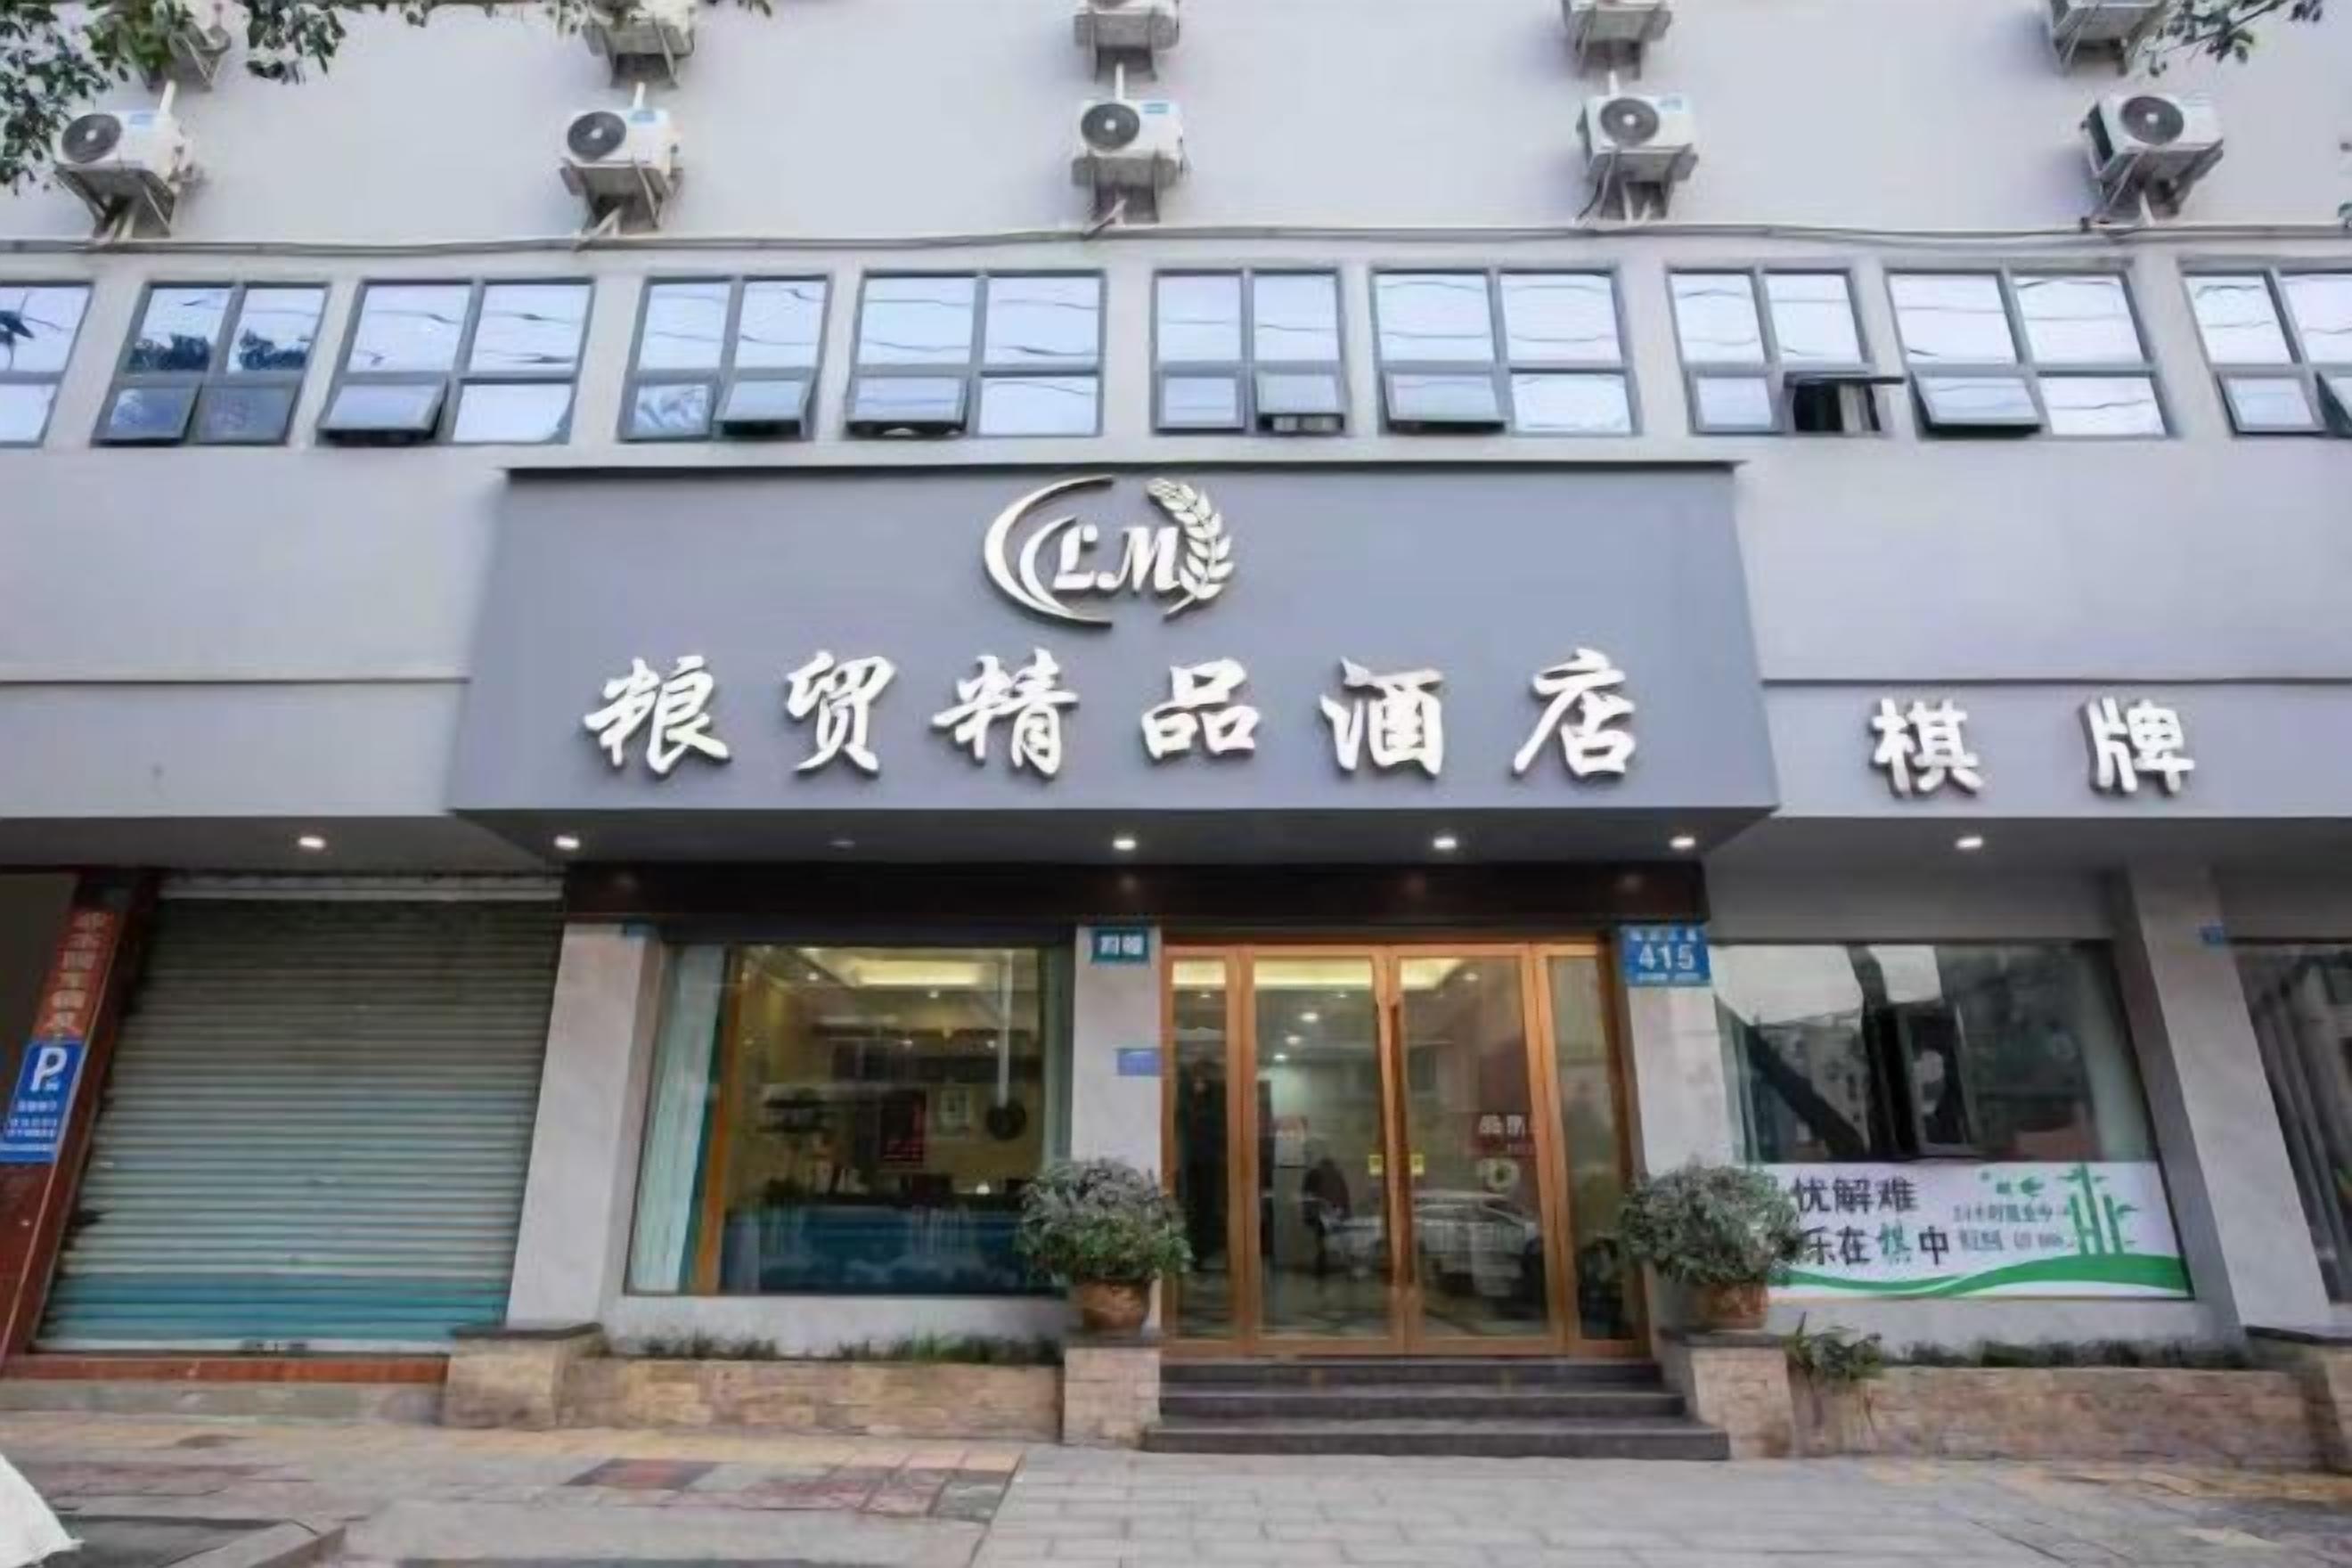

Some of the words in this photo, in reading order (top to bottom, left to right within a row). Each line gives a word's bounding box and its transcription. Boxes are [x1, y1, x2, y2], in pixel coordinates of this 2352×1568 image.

[584, 647, 1637, 778] 粮贸精品酒店
[1872, 697, 2195, 793] 棋牌
[1638, 943, 1695, 970] 415
